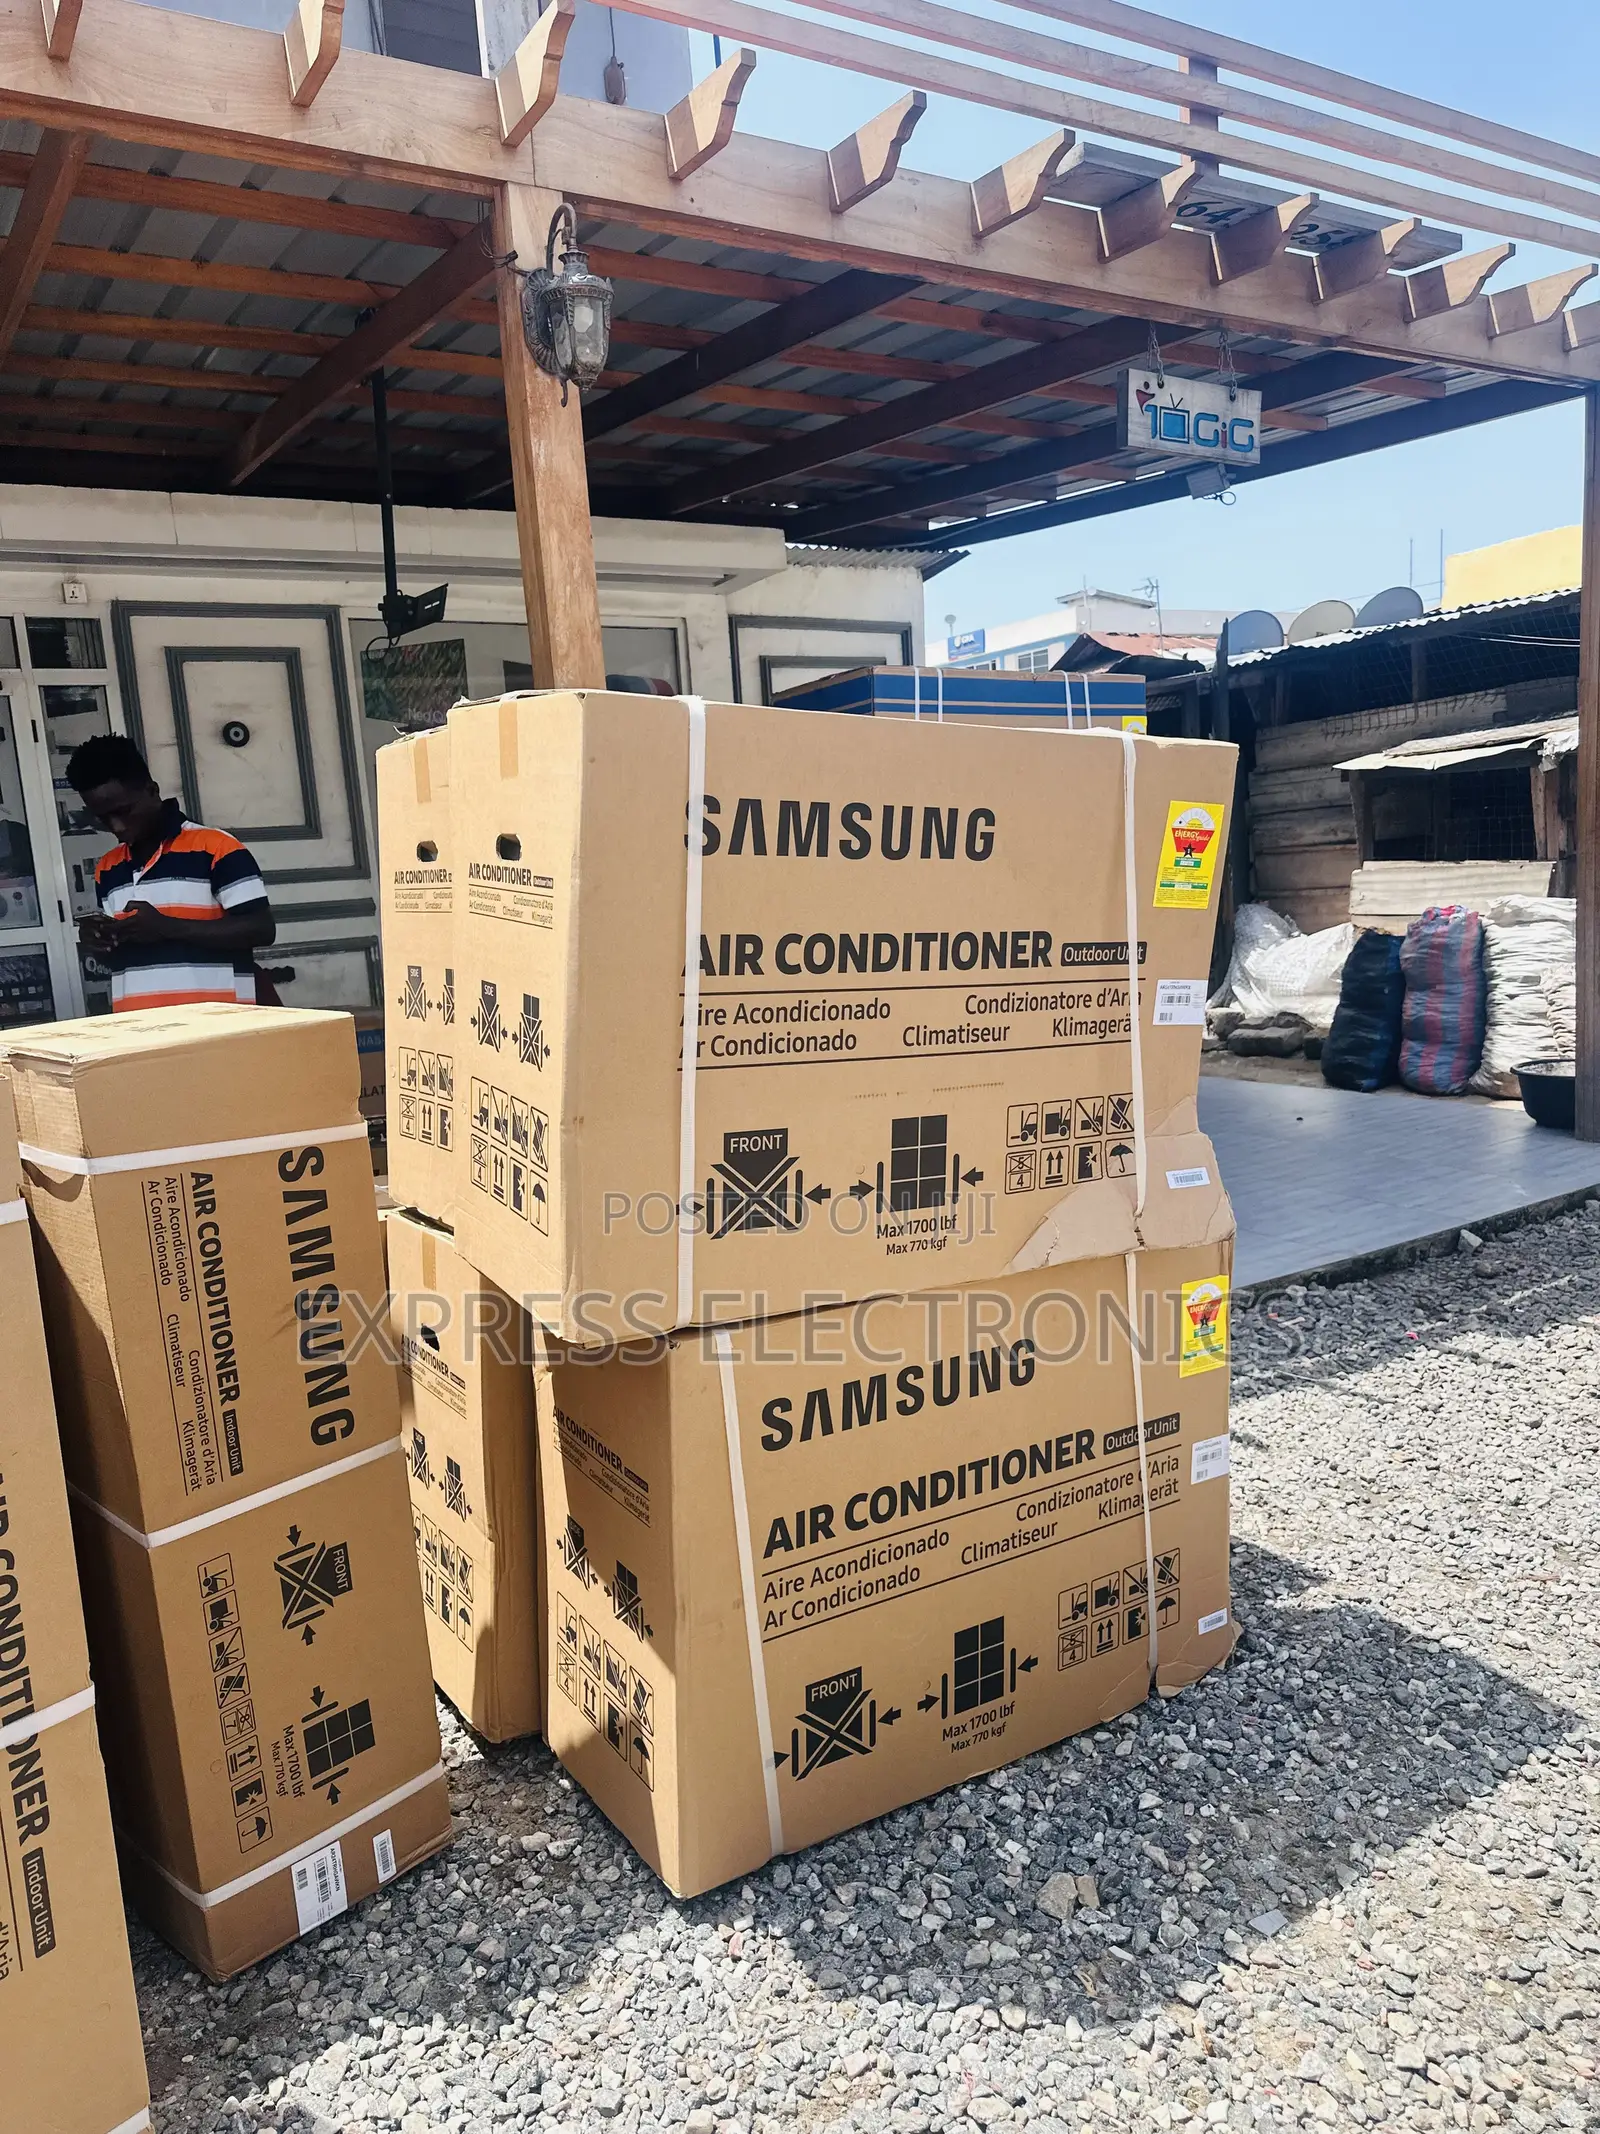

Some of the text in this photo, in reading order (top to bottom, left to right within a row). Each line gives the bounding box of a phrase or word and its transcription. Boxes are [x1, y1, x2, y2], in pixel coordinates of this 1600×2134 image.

[683, 795, 996, 861] SAMSUNG
[405, 869, 448, 884] CONDITIONER
[469, 863, 481, 879] AIR
[482, 864, 532, 886] CONDITIONER
[681, 934, 765, 976] AIR
[775, 931, 1052, 975] CONDITIONER
[1064, 946, 1116, 962] Outdoor
[484, 984, 494, 997] SIDE
[680, 1003, 727, 1027] ire
[733, 997, 891, 1026] Acondicionado
[965, 989, 1092, 1016] Condizionatore
[711, 1029, 857, 1058] Condicionado
[902, 1021, 1011, 1047] Climatiseur
[1053, 1013, 1140, 1039] Klimagerä
[730, 1133, 783, 1154] FRONT
[877, 1214, 957, 1239] Max 1700 lbf
[886, 1236, 947, 1255] Max 770 kgf
[277, 1146, 355, 1446] SAMSUNG
[148, 1180, 202, 1491] Ar Condicionado Climatiseur Klimagerät
[164, 1177, 216, 1485] Aire Acondicionado Condizionatore d'Aria
[190, 1171, 241, 1472] AIR CONDITIONER Indoor Unit
[761, 1338, 1036, 1452] SAMSUNG
[566, 1417, 623, 1474] CONDITIONER
[763, 1504, 836, 1559] AIR
[844, 1429, 1096, 1531] CONDITIONER
[1154, 1417, 1177, 1435] Unit
[764, 1577, 804, 1603] Aire
[810, 1529, 949, 1587] Acondicionado
[1016, 1471, 1133, 1521] Condizionatore
[333, 1548, 349, 1589] FRONT
[764, 1608, 787, 1632] Ar
[791, 1564, 920, 1620] Condicionado
[961, 1520, 1057, 1565] Climatiseur
[811, 1672, 858, 1702] FRONT
[942, 1700, 1015, 1741] Max 1700 lbf
[951, 1723, 1006, 1753] Max 770 kgf
[271, 1741, 288, 1797] Max 770 kgf
[283, 1724, 305, 1798] Max 1700 lbf
[26, 1855, 44, 1910] Indoor
[35, 1910, 51, 1949] Unit
